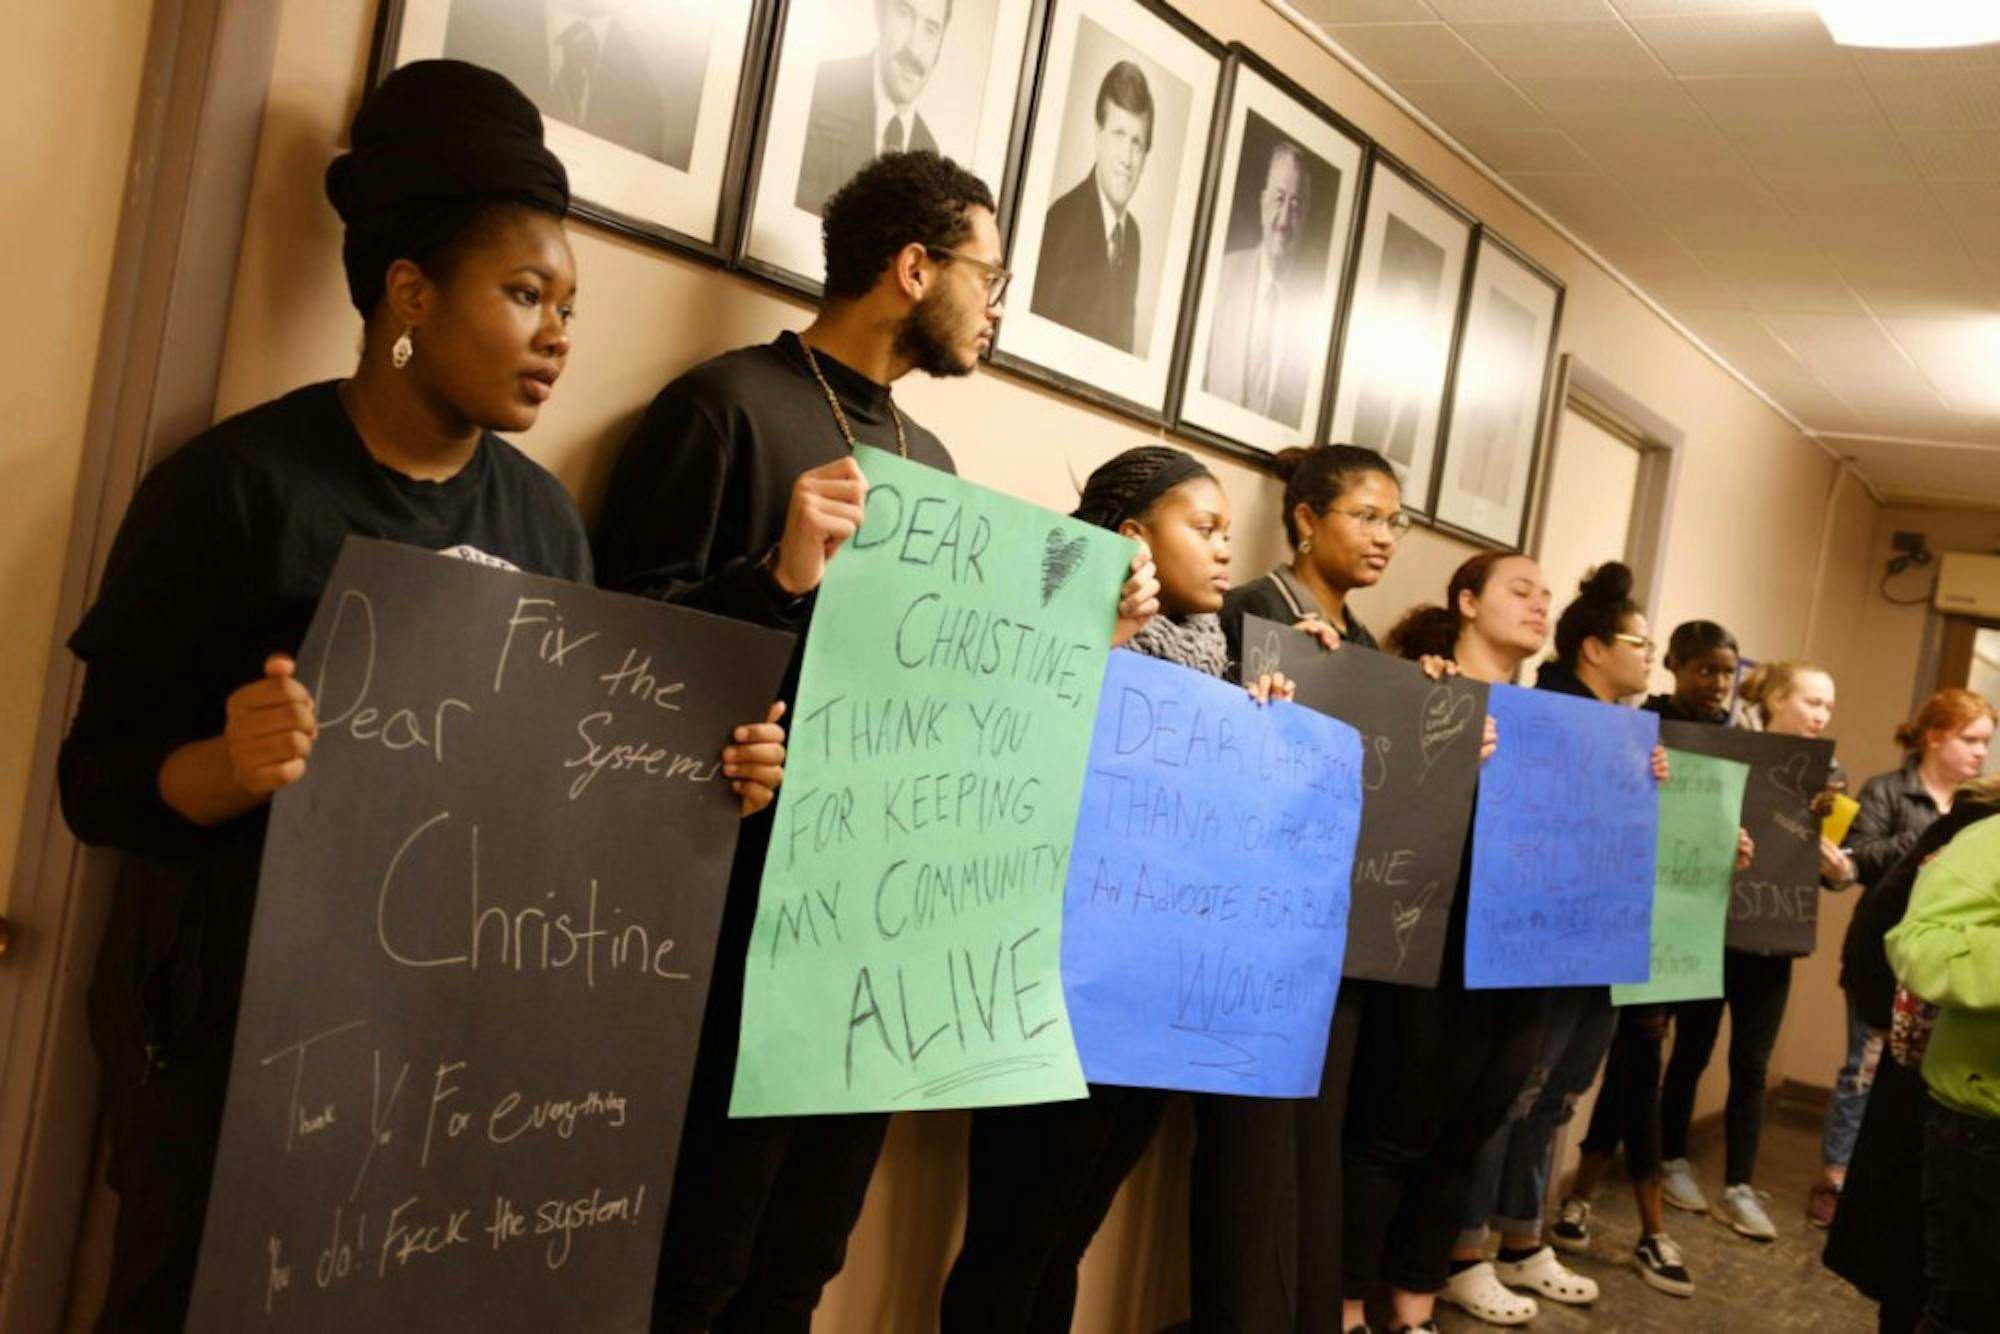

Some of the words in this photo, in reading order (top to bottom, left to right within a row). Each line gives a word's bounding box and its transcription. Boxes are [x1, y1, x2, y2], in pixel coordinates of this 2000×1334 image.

[852, 484, 991, 584] DEAR
[314, 589, 472, 763] Dear
[494, 597, 599, 692] Fix
[600, 648, 686, 711] the
[896, 593, 1092, 709] CHRISTINE,
[804, 696, 948, 763] THANK
[968, 702, 1032, 758] YOU
[1115, 687, 1244, 775] DEAR
[786, 786, 859, 872] FOR
[884, 772, 1041, 842] KEEPING
[1094, 769, 1222, 838] THANK
[376, 811, 692, 988] Christine
[771, 880, 842, 969] MY
[875, 844, 1069, 941] COMMUNITY
[846, 928, 1058, 1090] ALIVE
[485, 1197, 527, 1251] the
[534, 1184, 647, 1270] system!
